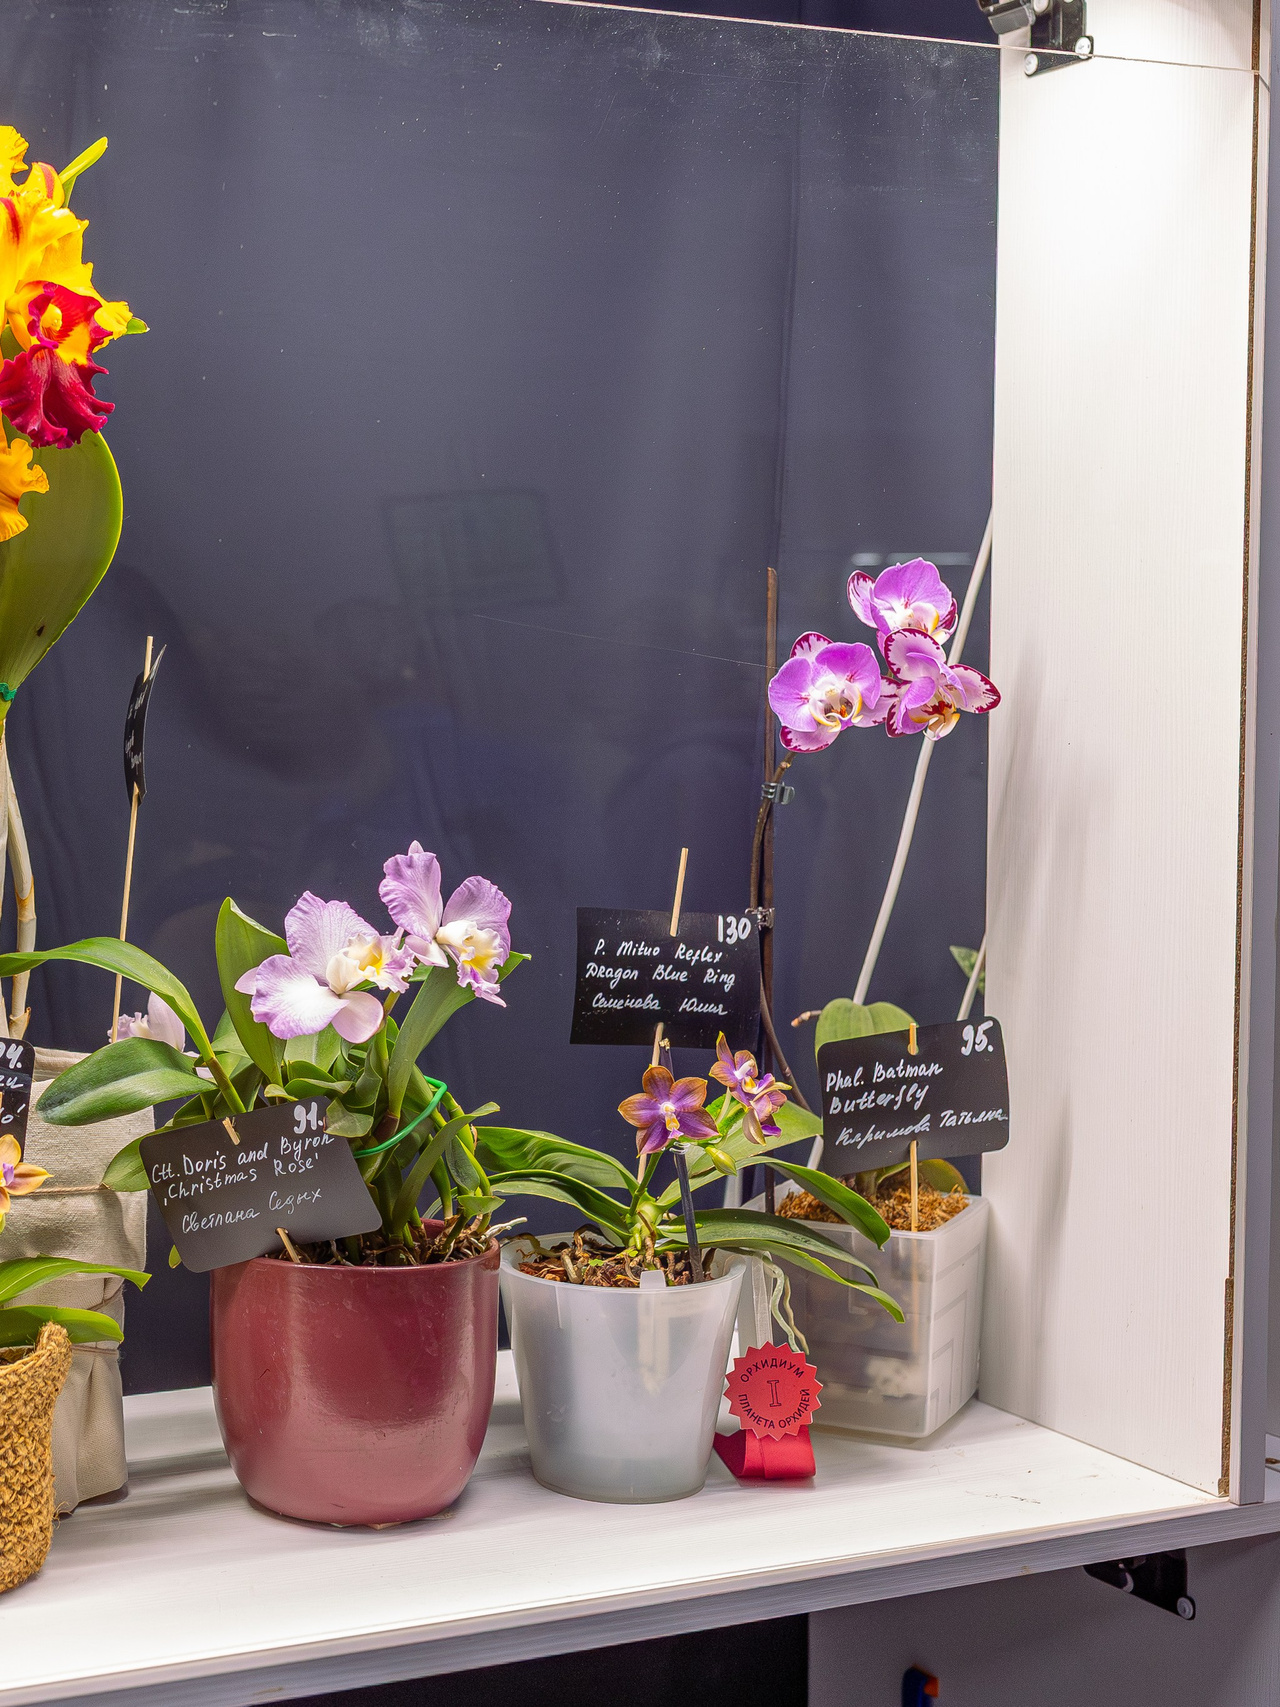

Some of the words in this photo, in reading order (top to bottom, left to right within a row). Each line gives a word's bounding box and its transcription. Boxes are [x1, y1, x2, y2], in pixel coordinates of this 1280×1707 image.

[717, 914, 751, 945] 130
[594, 938, 606, 956] P.
[616, 940, 660, 957] Mituo
[675, 942, 723, 966] Reflex
[652, 964, 688, 982] Blue
[703, 968, 735, 993] Ring
[825, 1066, 864, 1092] Phal.
[872, 1058, 944, 1083] Batman
[829, 1083, 930, 1115] Butterfly
[183, 1151, 227, 1176] Doris
[237, 1142, 269, 1165] and
[280, 1132, 335, 1163] Byron
[182, 1205, 260, 1234] Светлана
[740, 1358, 805, 1383] ОРХИДИУМ
[766, 1380, 782, 1407] I
[738, 1394, 775, 1429] ПЛАНЕТА
[778, 1389, 810, 1429] ОРХИДЕЙ
